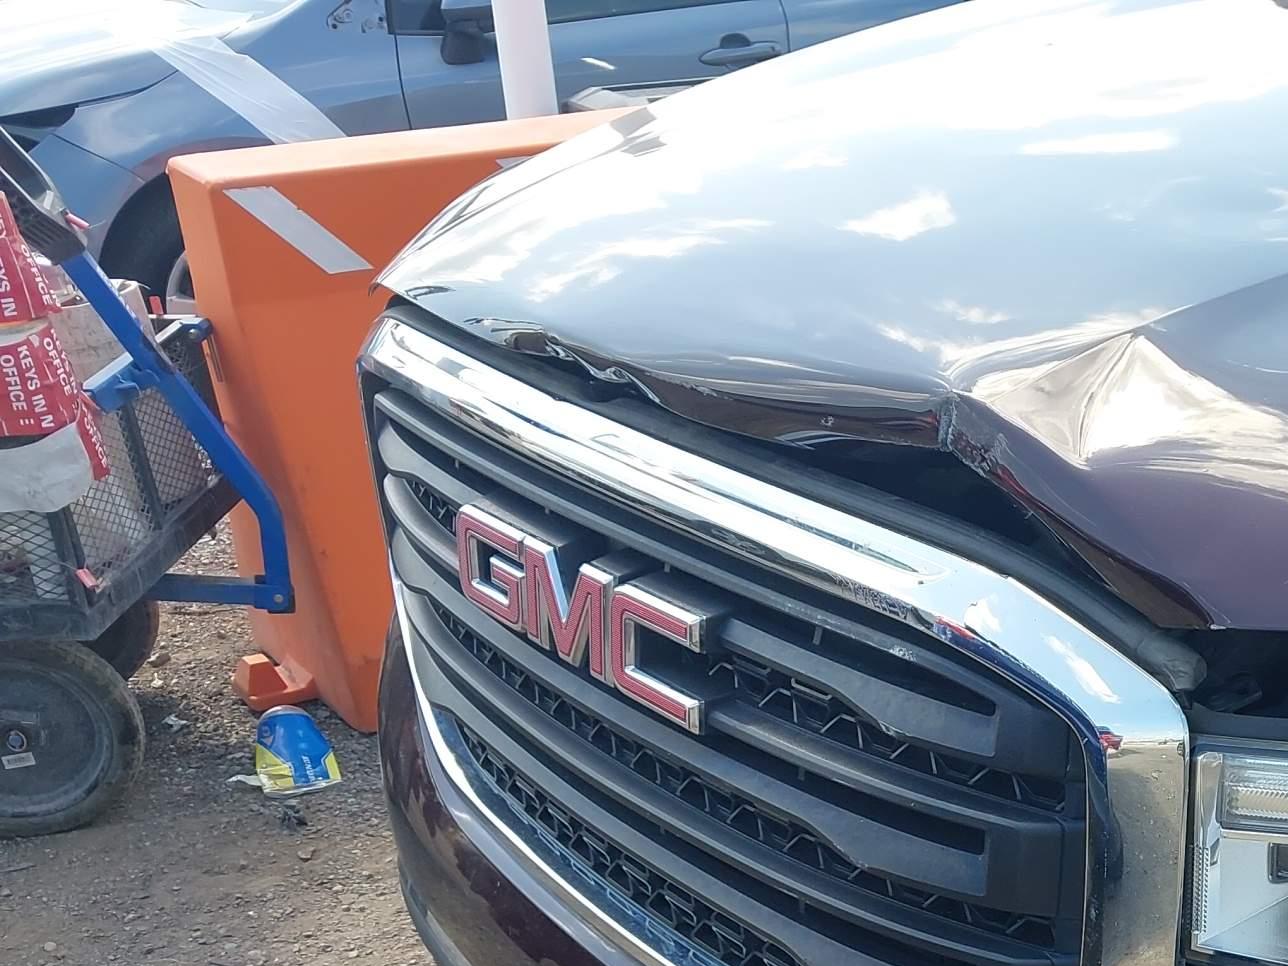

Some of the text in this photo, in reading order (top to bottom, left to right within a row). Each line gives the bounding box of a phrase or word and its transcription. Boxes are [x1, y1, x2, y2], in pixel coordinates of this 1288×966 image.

[20, 244, 52, 304] OFFICE
[2, 297, 17, 317] IN
[0, 354, 27, 411] OFFICE
[17, 345, 41, 391] KEYS
[31, 394, 47, 413] IN
[43, 337, 72, 396] OFFICE
[456, 503, 706, 735] GMC
